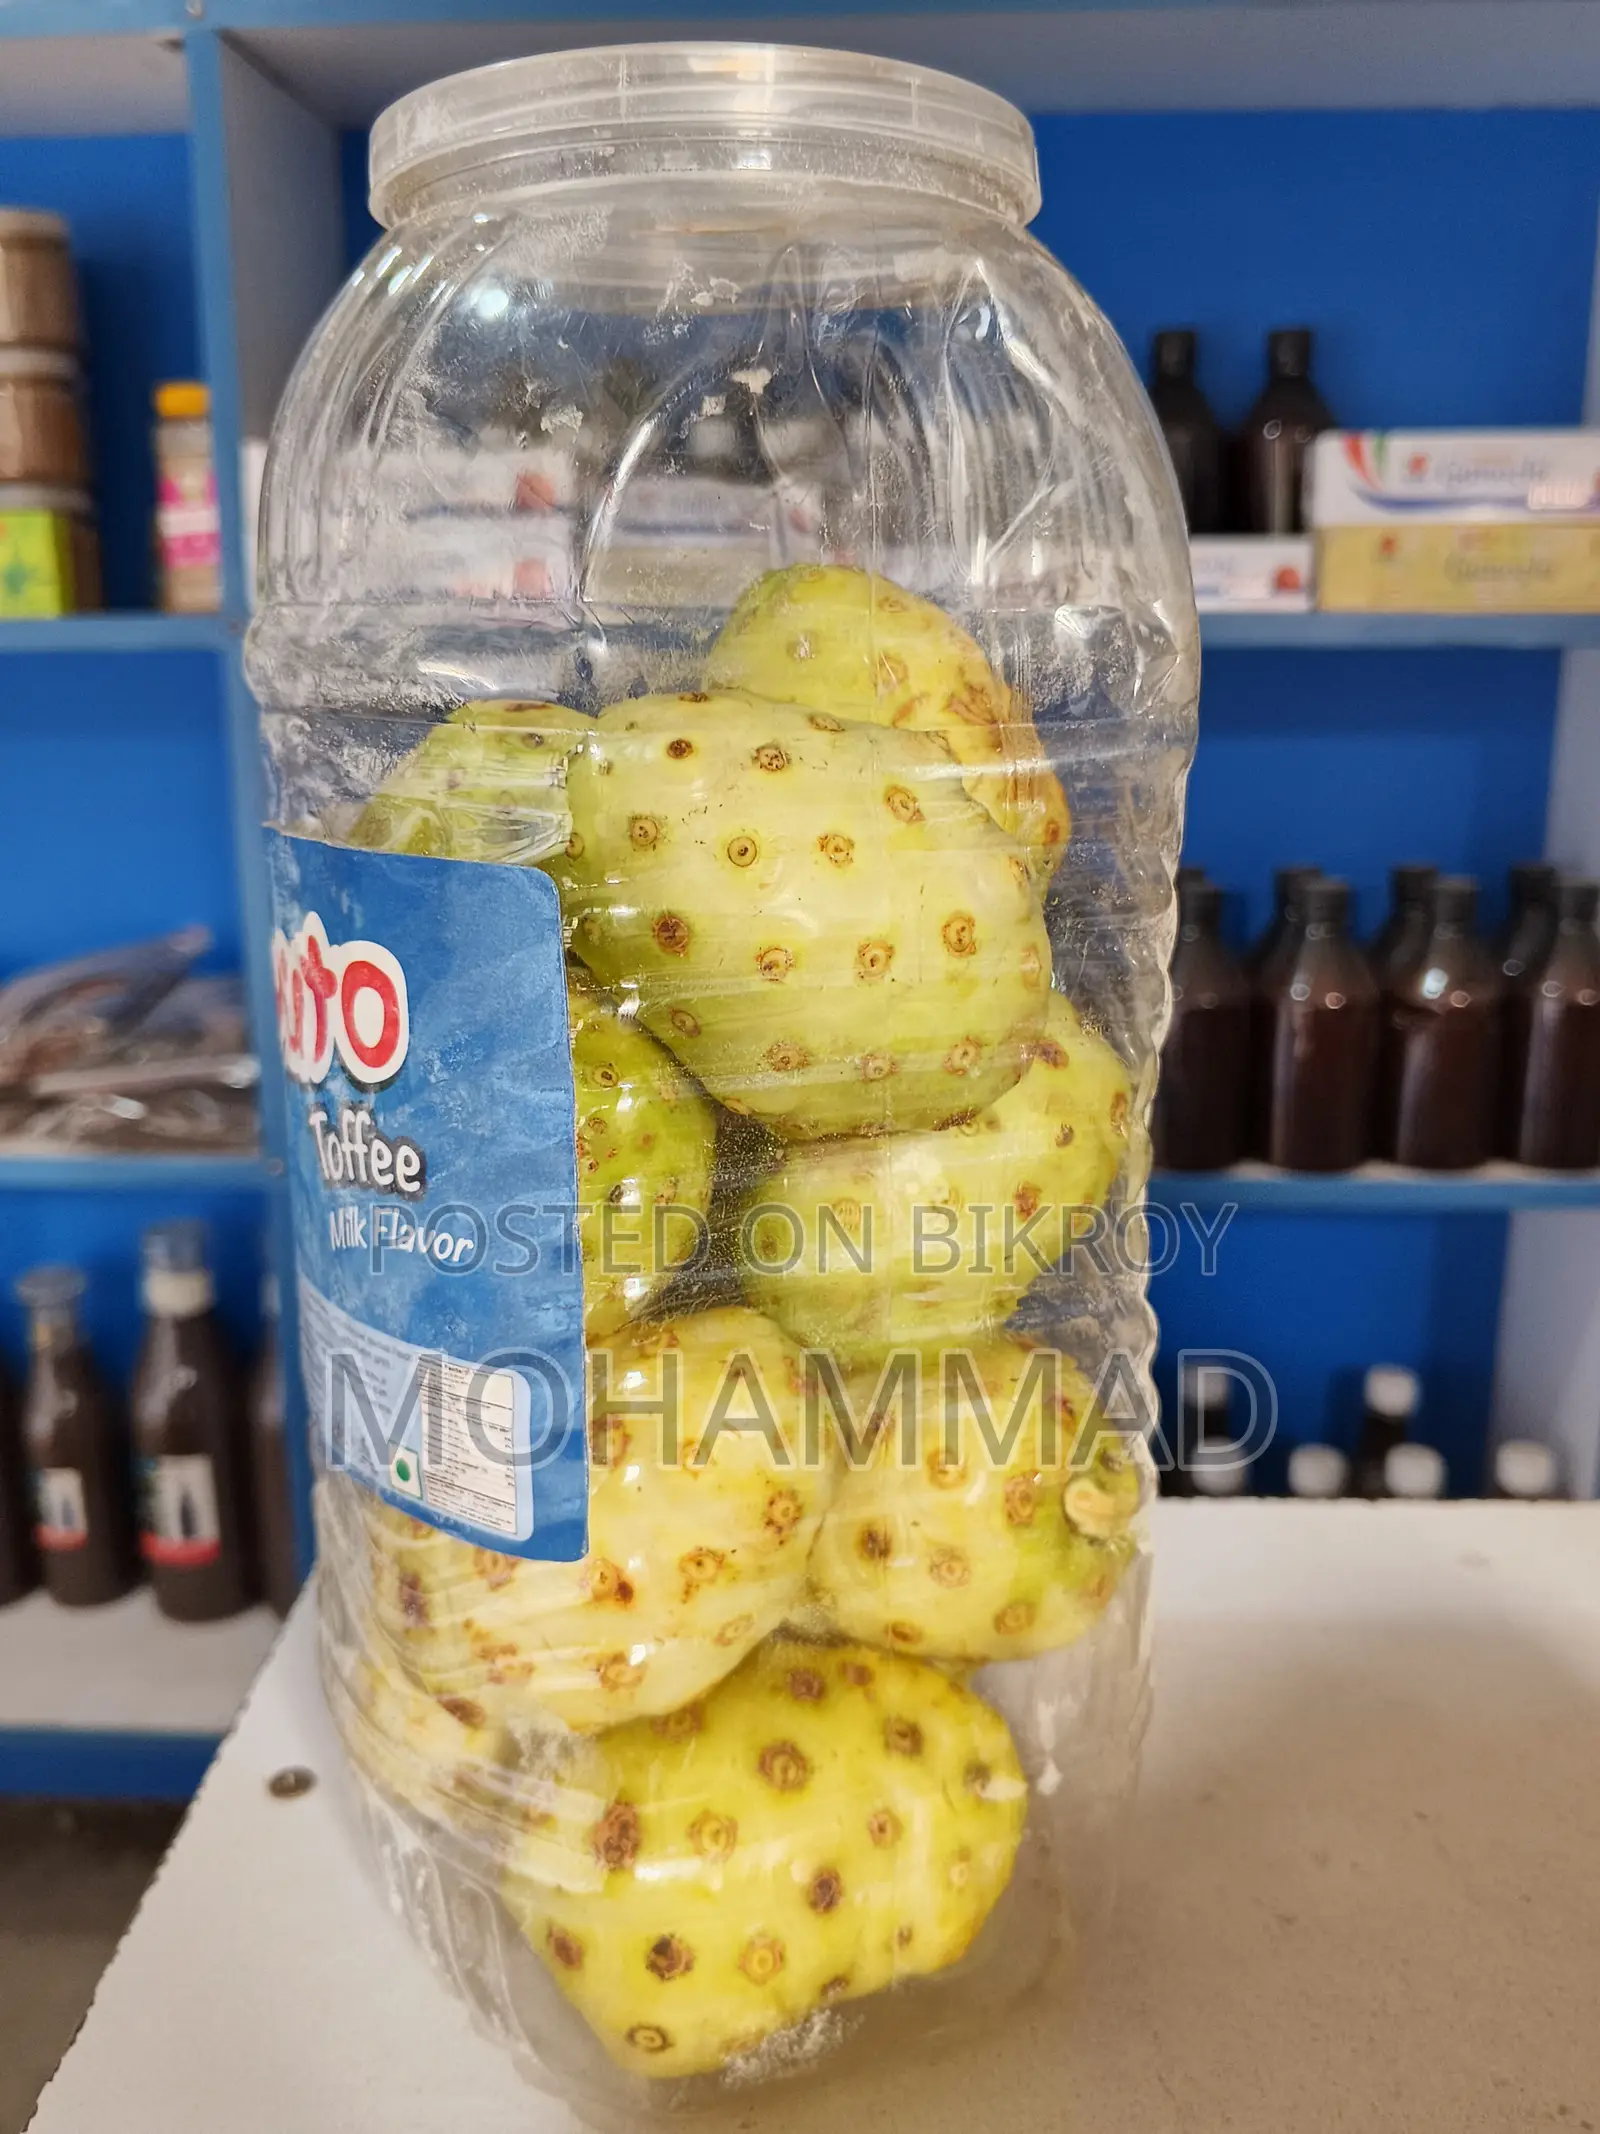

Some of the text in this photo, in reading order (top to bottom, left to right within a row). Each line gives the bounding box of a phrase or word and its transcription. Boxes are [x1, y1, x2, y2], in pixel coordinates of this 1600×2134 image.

[308, 1109, 422, 1193] Toffee
[329, 1205, 474, 1262] Milk Flavor
